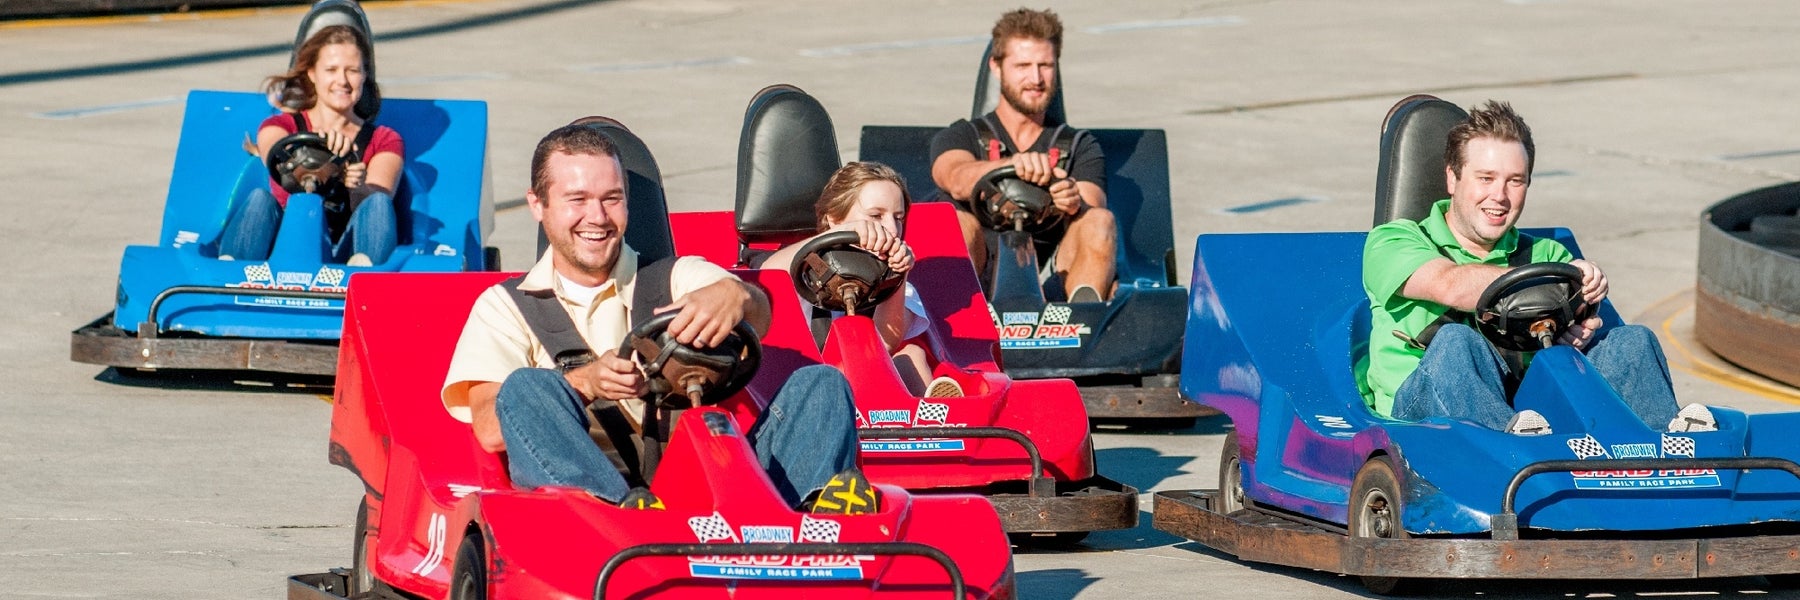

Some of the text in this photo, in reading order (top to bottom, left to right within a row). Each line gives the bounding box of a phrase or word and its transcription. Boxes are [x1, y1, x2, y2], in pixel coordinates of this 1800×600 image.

[1035, 325, 1081, 338] PRIX
[869, 410, 910, 424] BROADWAY
[1613, 444, 1656, 458] BROADWAY
[743, 527, 792, 543] BROADWAY
[719, 567, 833, 577] FAMILY RACE PARK
